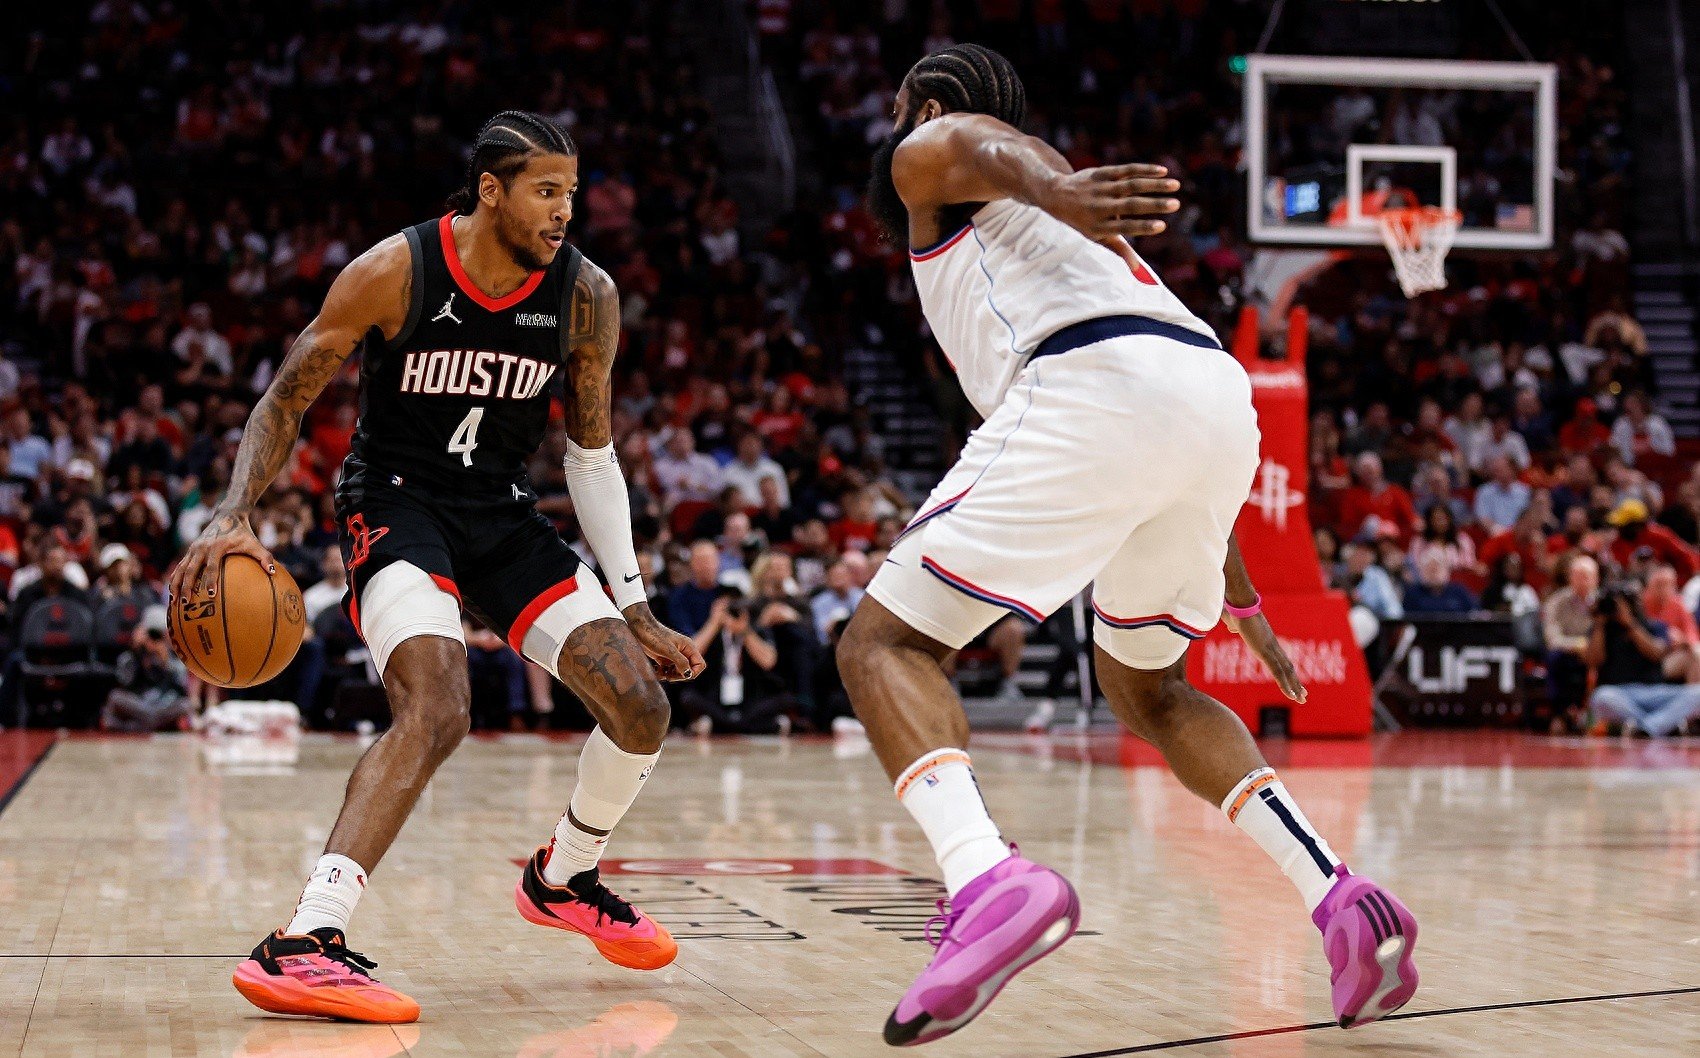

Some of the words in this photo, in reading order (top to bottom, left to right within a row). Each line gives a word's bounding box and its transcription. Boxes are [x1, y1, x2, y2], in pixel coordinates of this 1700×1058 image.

[514, 318, 557, 328] HERMANN
[515, 312, 557, 324] MEMORIAL
[401, 350, 556, 399] HOUSTON
[447, 406, 485, 467] 4
[1407, 645, 1519, 693] LIFT
